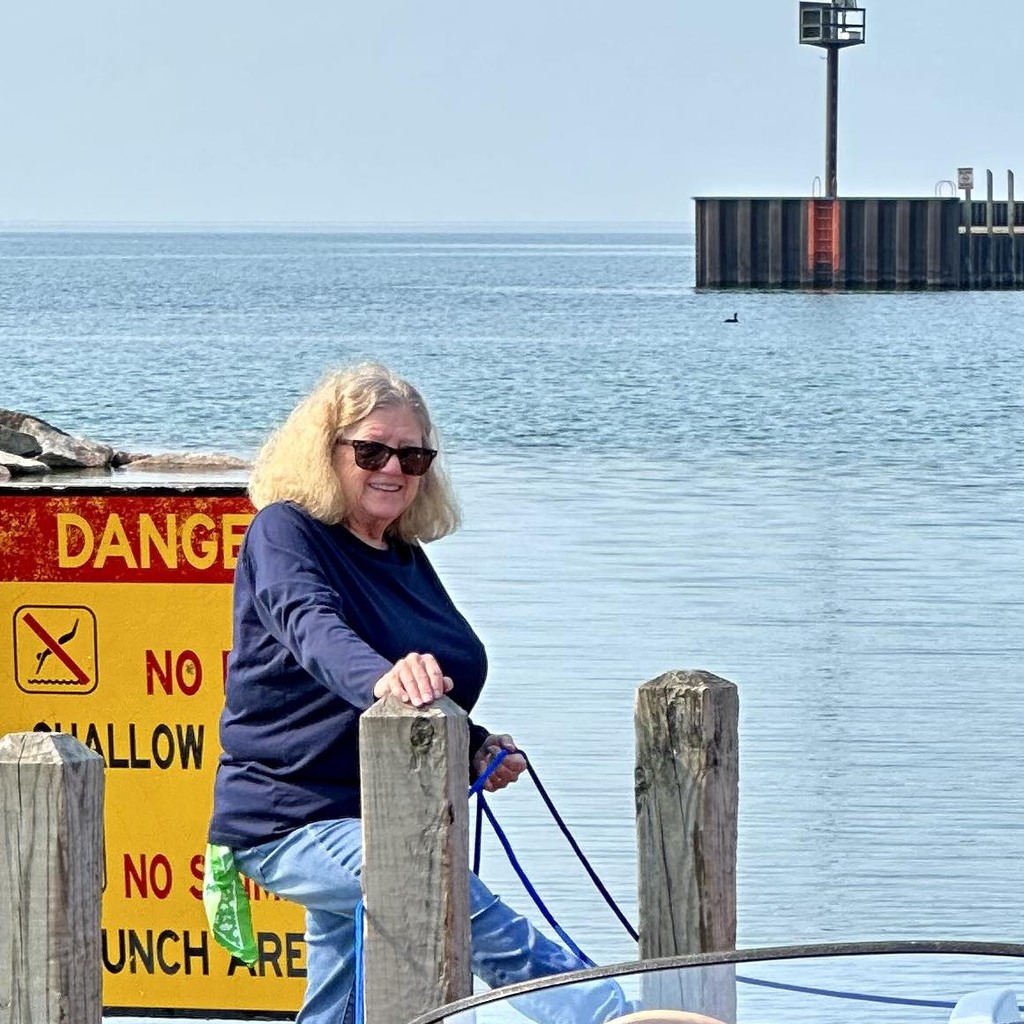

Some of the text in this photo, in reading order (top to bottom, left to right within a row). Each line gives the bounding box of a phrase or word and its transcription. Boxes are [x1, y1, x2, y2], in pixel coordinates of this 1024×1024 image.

[56, 512, 255, 570] DANGE
[145, 649, 203, 696] NO
[33, 722, 205, 770] ALLOW
[123, 853, 173, 900] NO
[101, 929, 209, 976] UNCH
